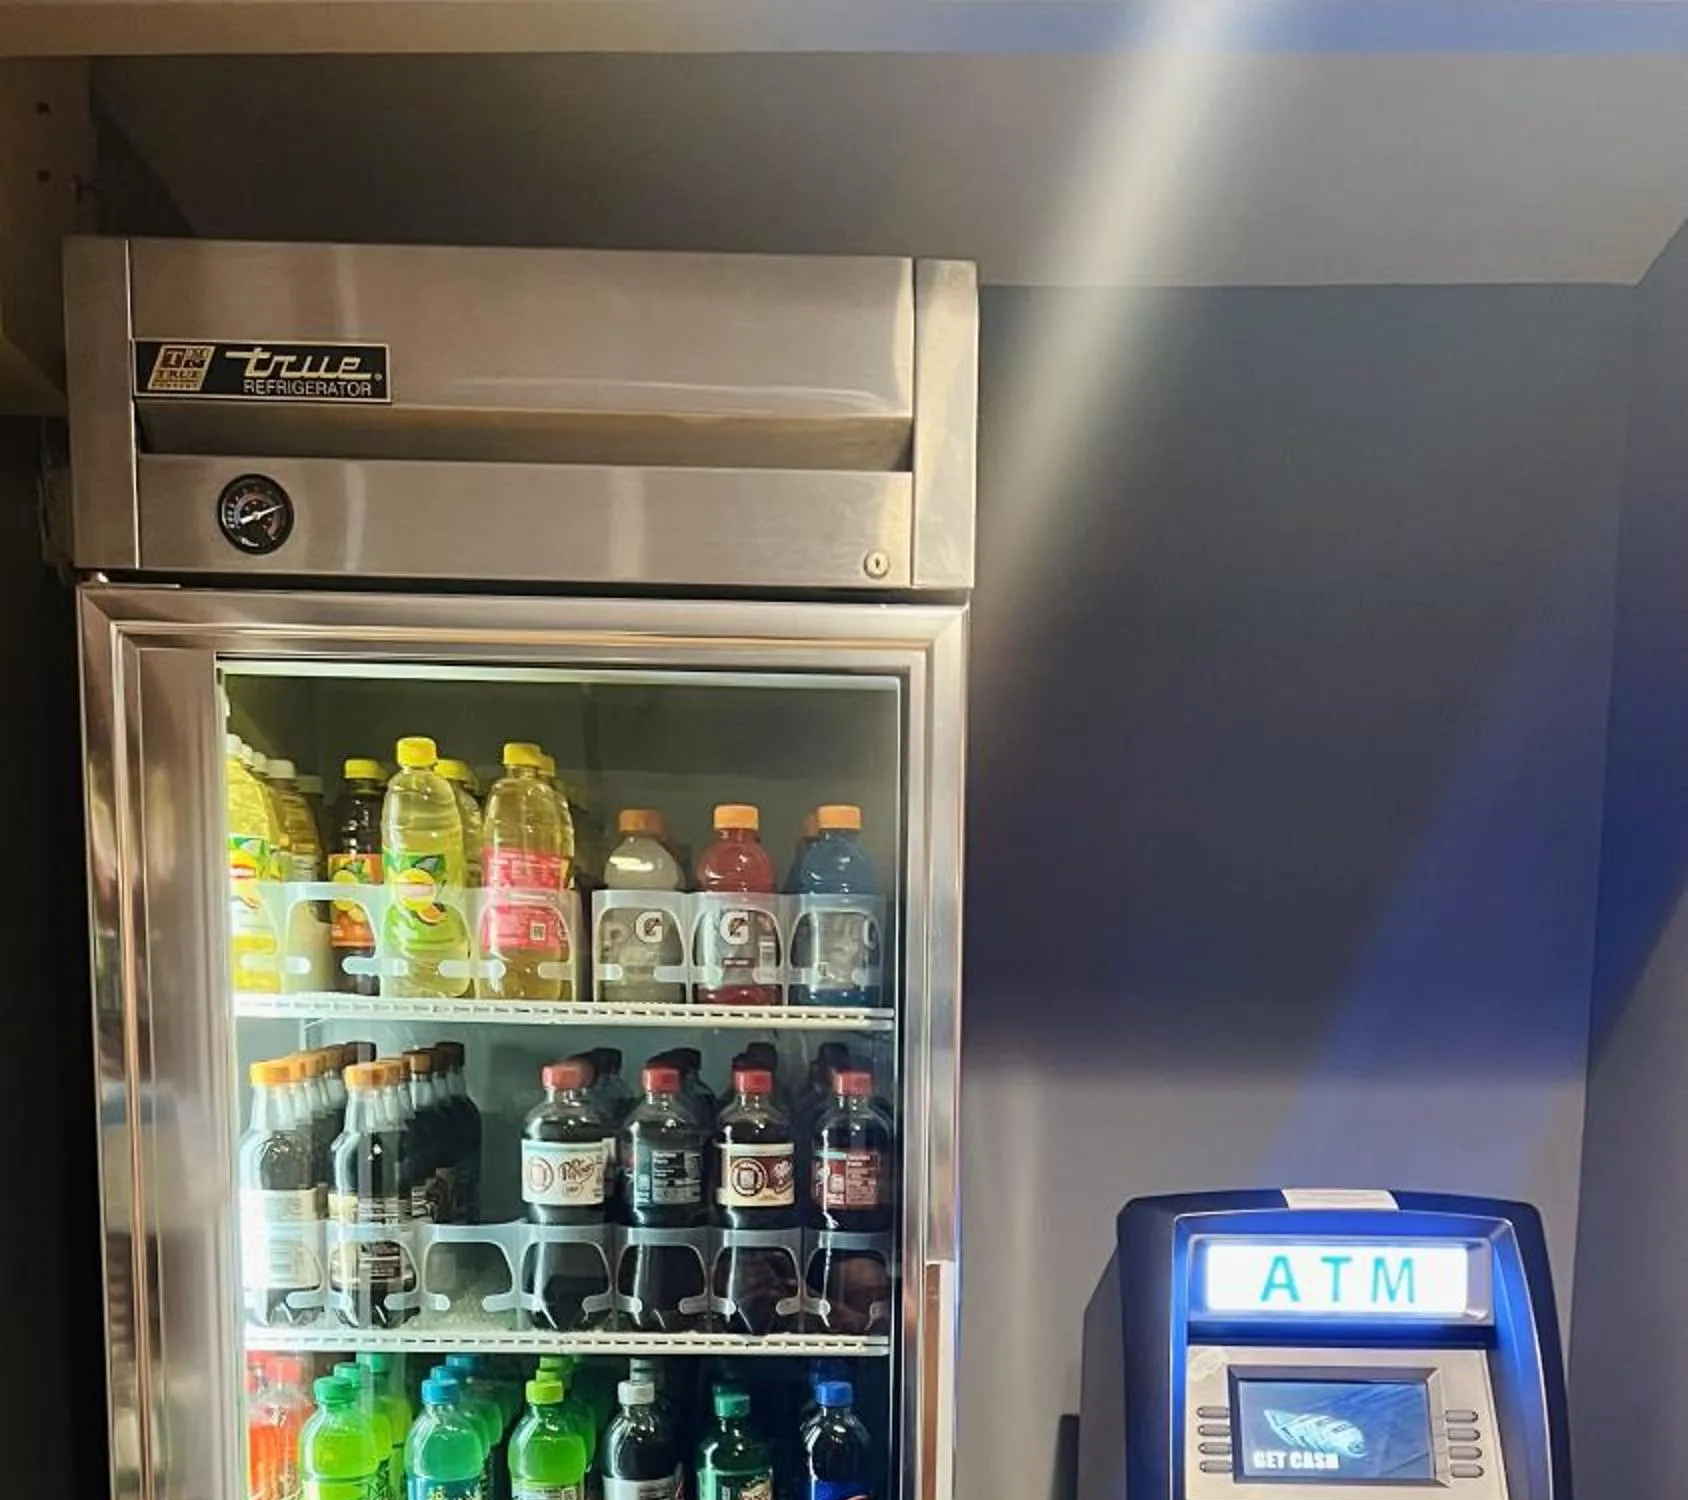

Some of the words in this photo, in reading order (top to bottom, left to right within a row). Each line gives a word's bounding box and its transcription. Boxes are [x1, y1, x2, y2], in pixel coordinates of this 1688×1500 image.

[243, 379, 372, 397] REFRIGERATOR
[1259, 1254, 1416, 1304] ATM
[1253, 1450, 1286, 1469] GET
[1289, 1450, 1339, 1470] CASH
